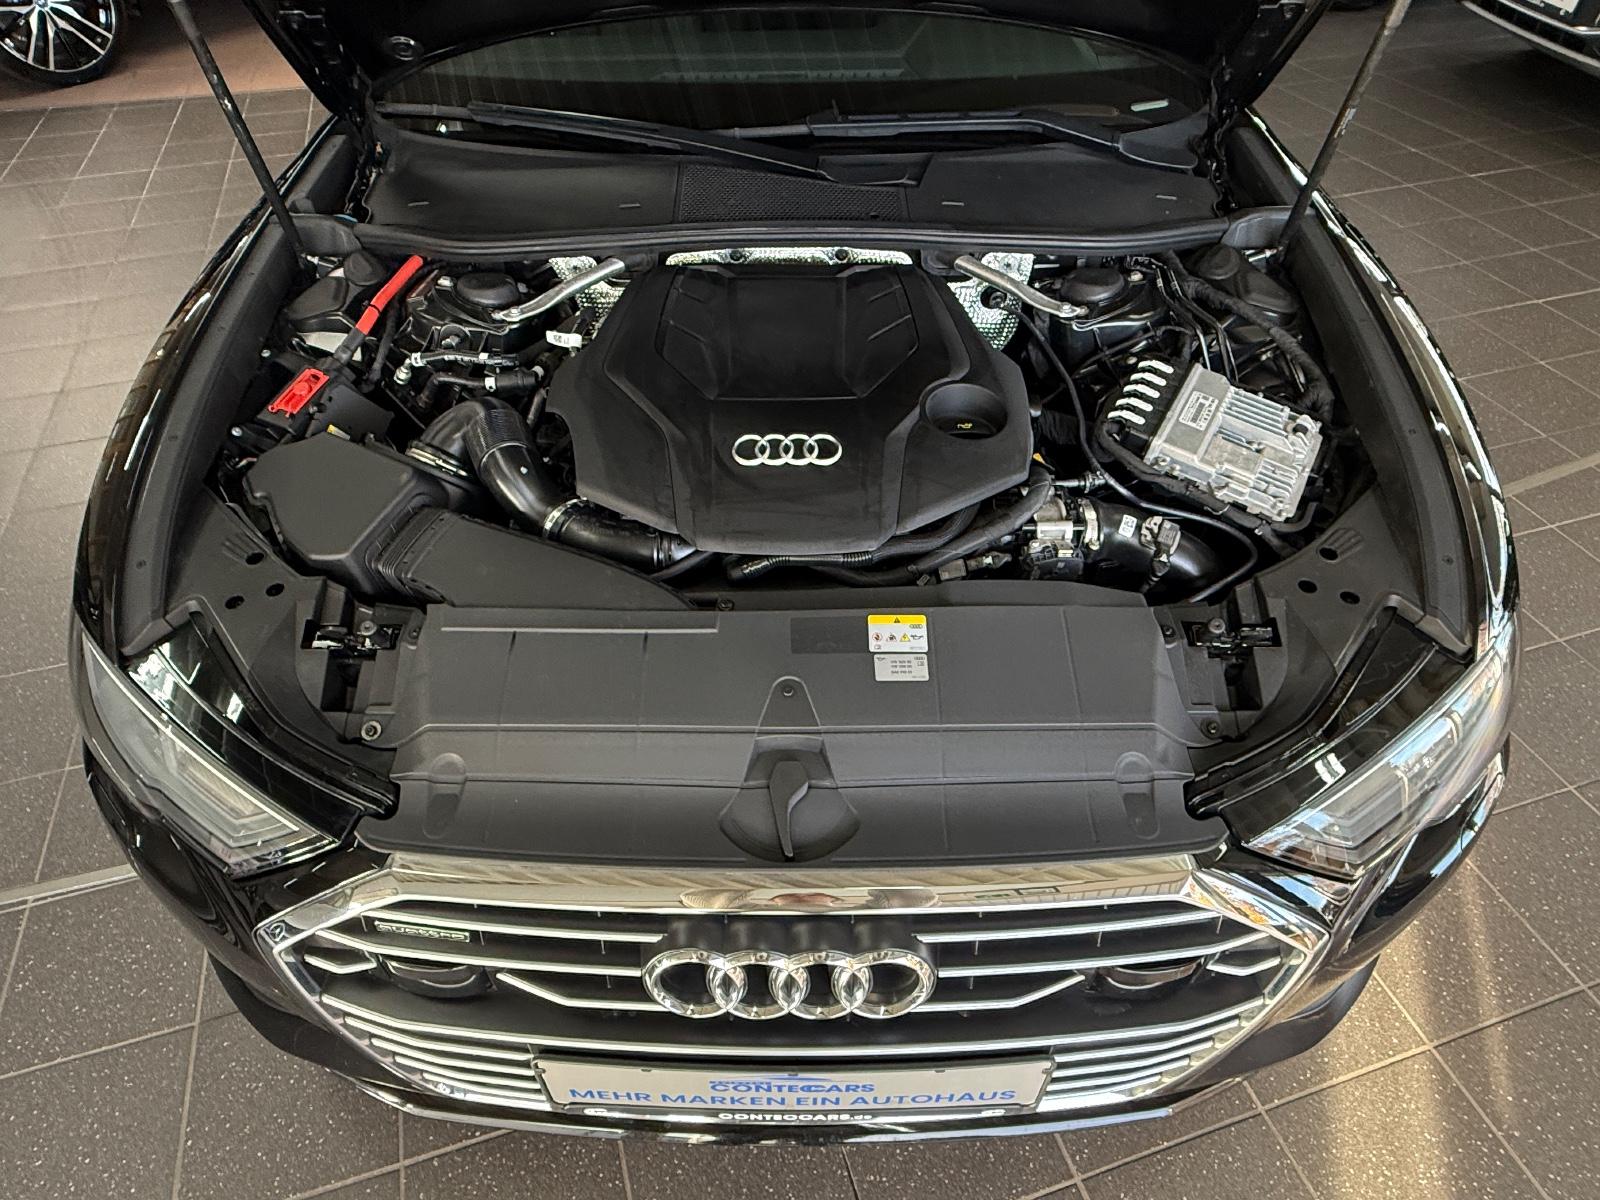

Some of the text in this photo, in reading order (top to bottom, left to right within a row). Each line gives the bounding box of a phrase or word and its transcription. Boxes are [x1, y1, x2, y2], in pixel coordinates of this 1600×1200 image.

[569, 1088, 1017, 1106] MEHR MARKEN EIN AUTOHAUS
